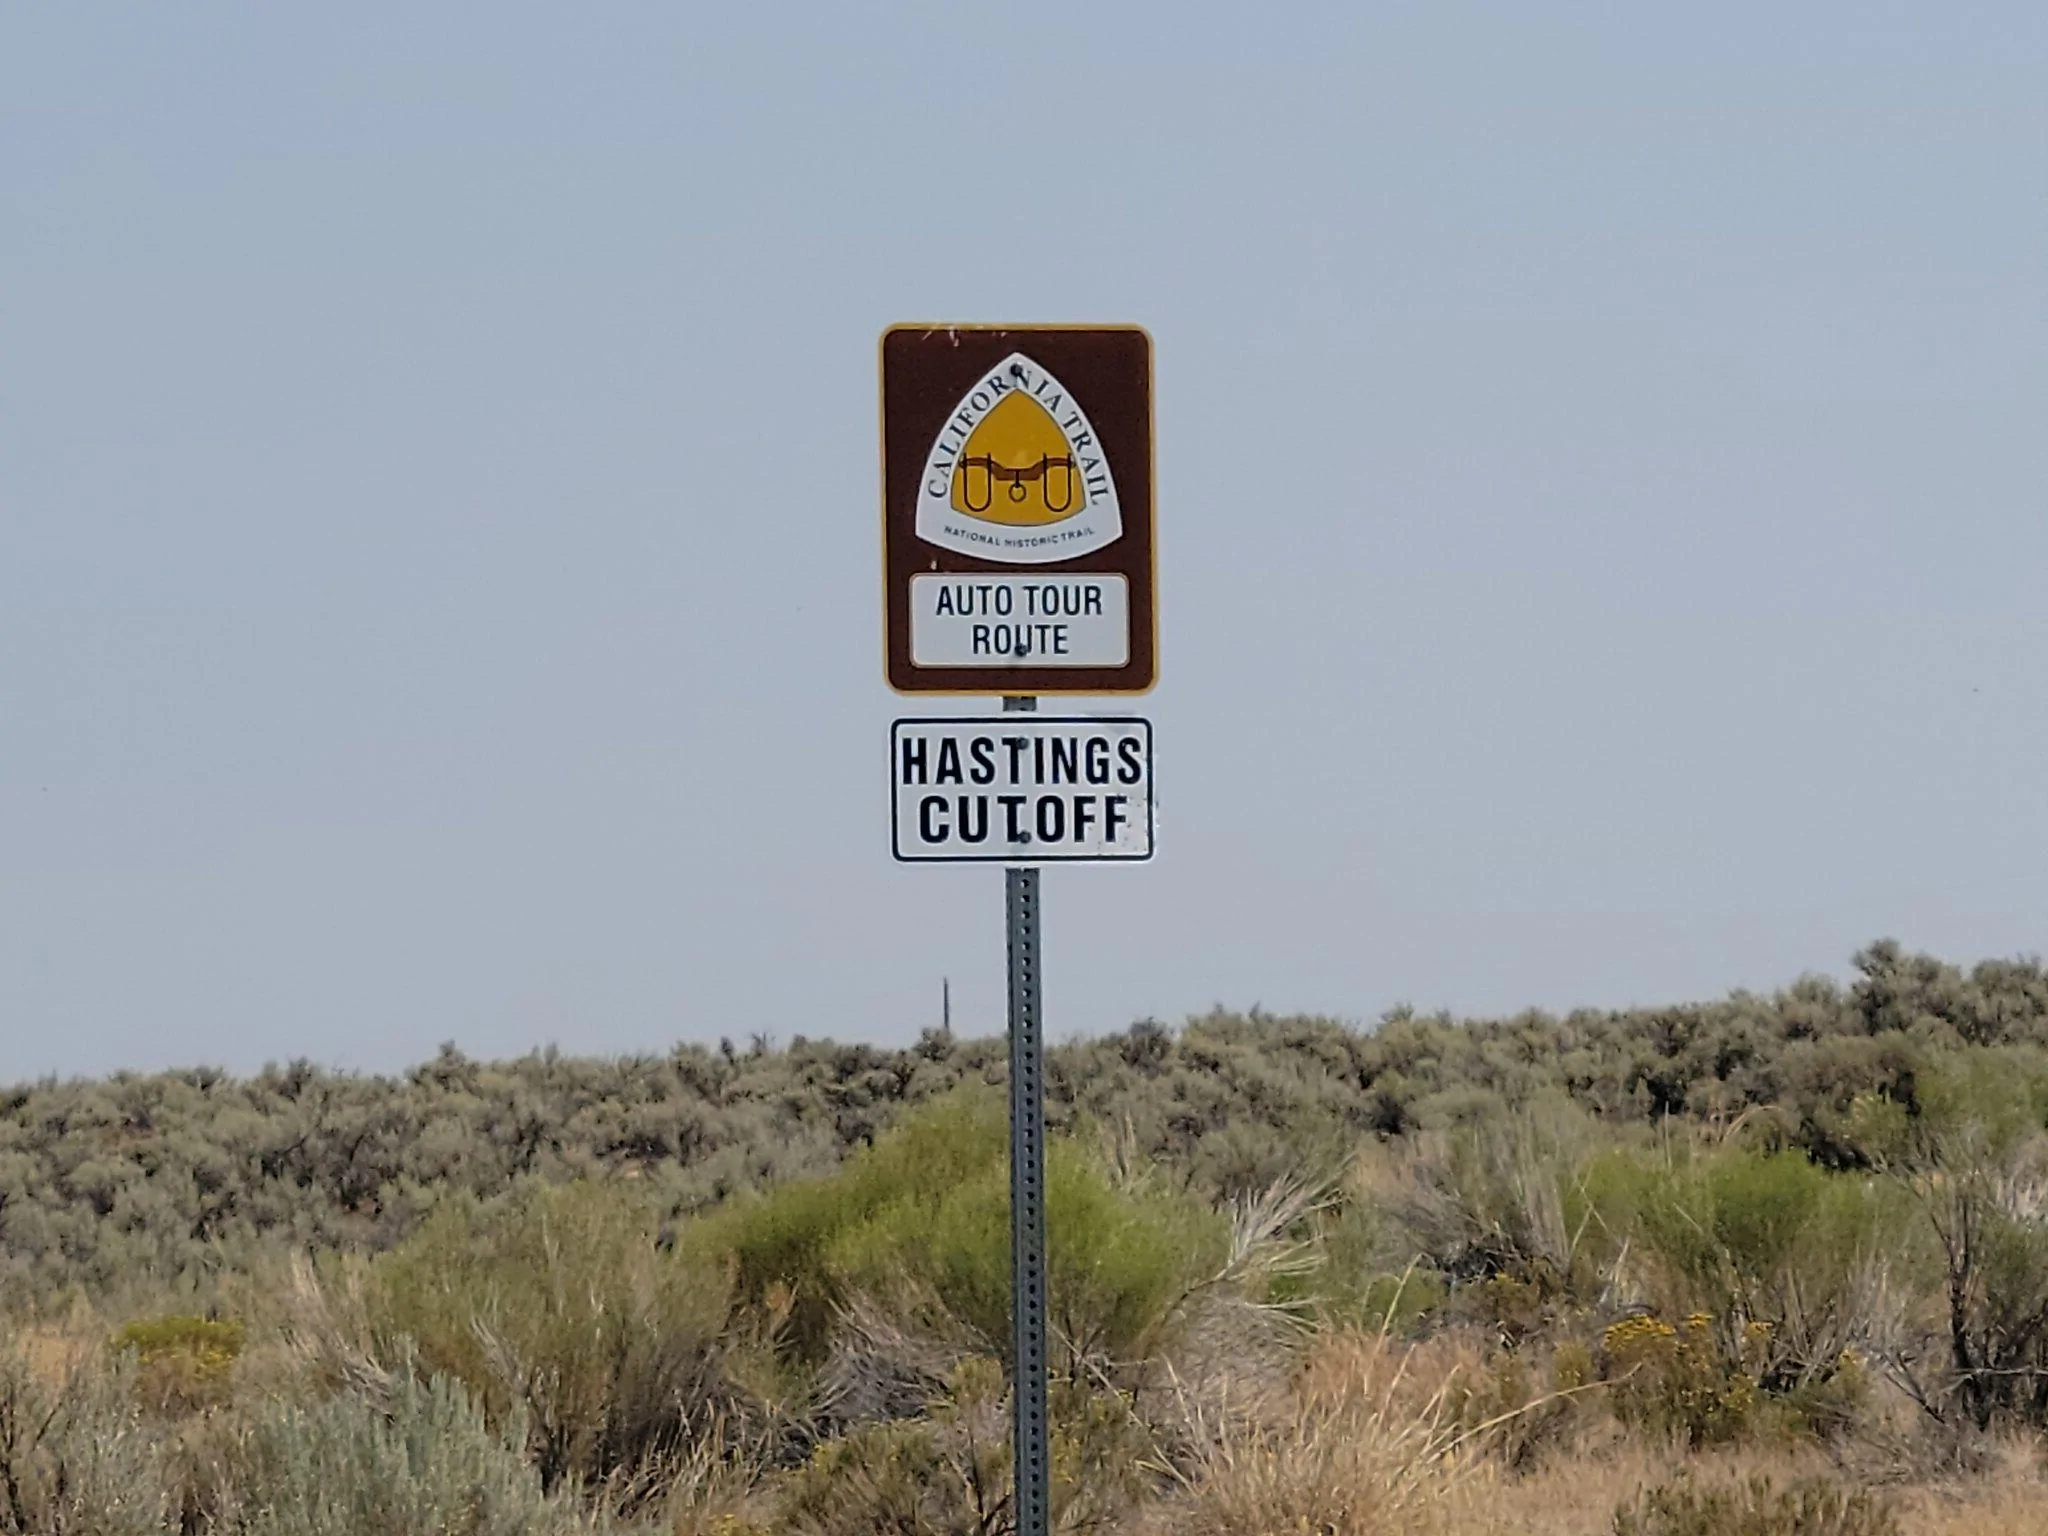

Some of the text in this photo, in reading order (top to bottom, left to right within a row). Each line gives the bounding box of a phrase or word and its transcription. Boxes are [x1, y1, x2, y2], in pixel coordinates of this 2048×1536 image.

[928, 369, 1109, 506] CALIFORNIA TRAIL
[944, 525, 1095, 548] NATIONAL HISTORIC TRAIL
[935, 585, 1102, 616] AUTO TOUR
[972, 624, 1069, 656] ROUTE
[903, 736, 1142, 785] HASTINGS
[919, 794, 1128, 844] CUTOFF
